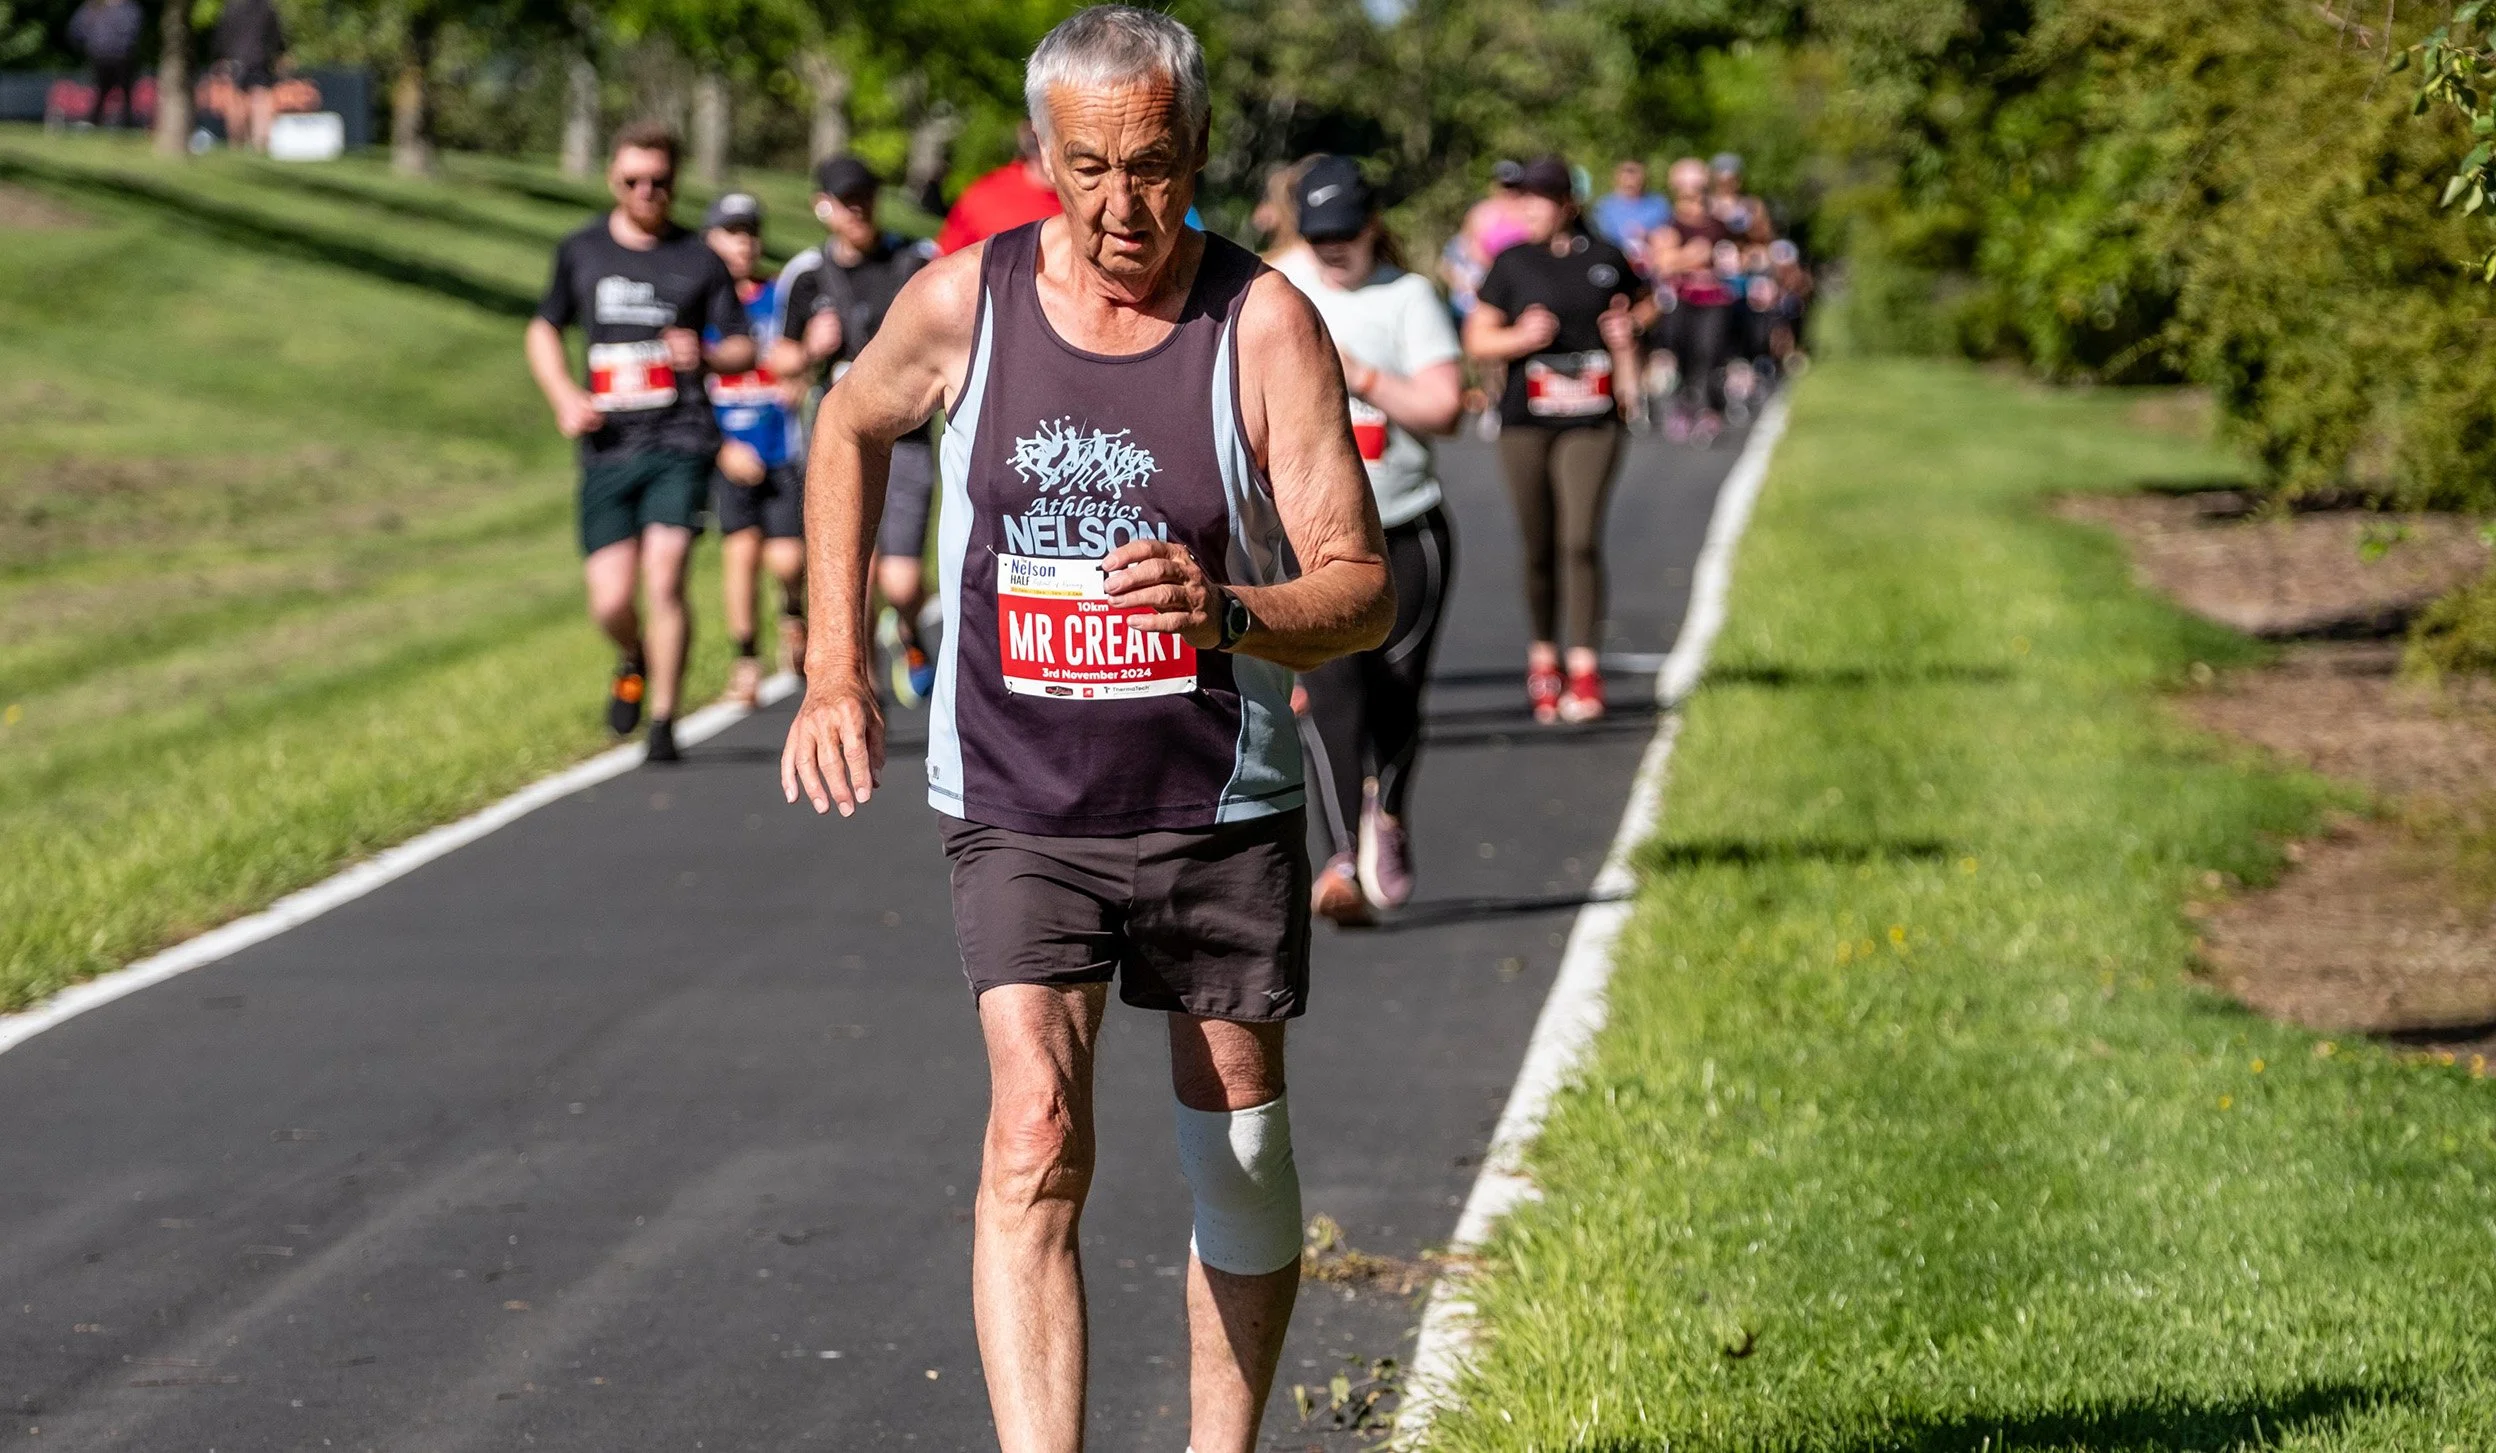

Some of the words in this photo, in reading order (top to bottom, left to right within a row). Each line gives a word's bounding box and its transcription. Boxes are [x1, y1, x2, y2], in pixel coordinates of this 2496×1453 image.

[1024, 496, 1142, 520] Athletics
[1002, 514, 1168, 558] NELSON
[1010, 558, 1056, 577] Nelson
[1010, 574, 1030, 586] HALF
[1077, 602, 1109, 612] 10km
[1008, 610, 1057, 664] MR
[1042, 667, 1061, 679] 3rd
[1062, 668, 1118, 680] November
[1120, 667, 1152, 679] 2024
